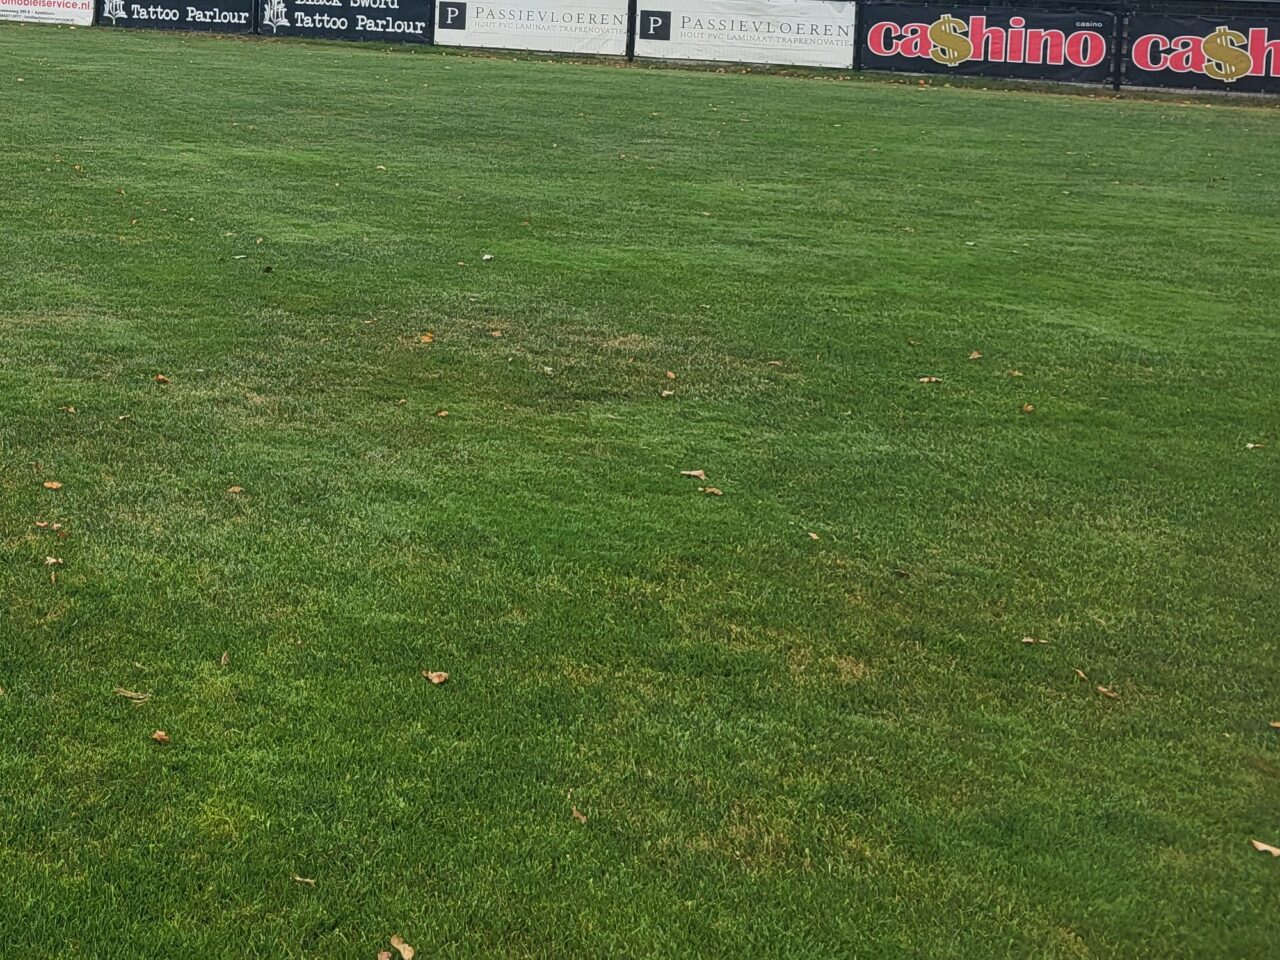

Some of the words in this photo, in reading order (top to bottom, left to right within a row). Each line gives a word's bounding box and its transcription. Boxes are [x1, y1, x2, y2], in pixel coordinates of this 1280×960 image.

[131, 4, 179, 21] Tattoo
[186, 6, 249, 24] Parlour
[294, 12, 348, 30] Tattoo
[356, 15, 425, 34] Parlour
[446, 7, 459, 24] P
[475, 6, 624, 26] PASSIEVLOEREN
[474, 21, 497, 29] HOUT
[498, 22, 515, 30] PVC
[515, 23, 557, 32] LAMINAAT
[648, 16, 662, 34] P
[681, 16, 849, 37] PASSIEVLOEREN
[1075, 20, 1103, 28] casino
[680, 31, 706, 39] HOUT
[707, 32, 724, 40] PVC
[726, 33, 774, 43] LAMINAAT
